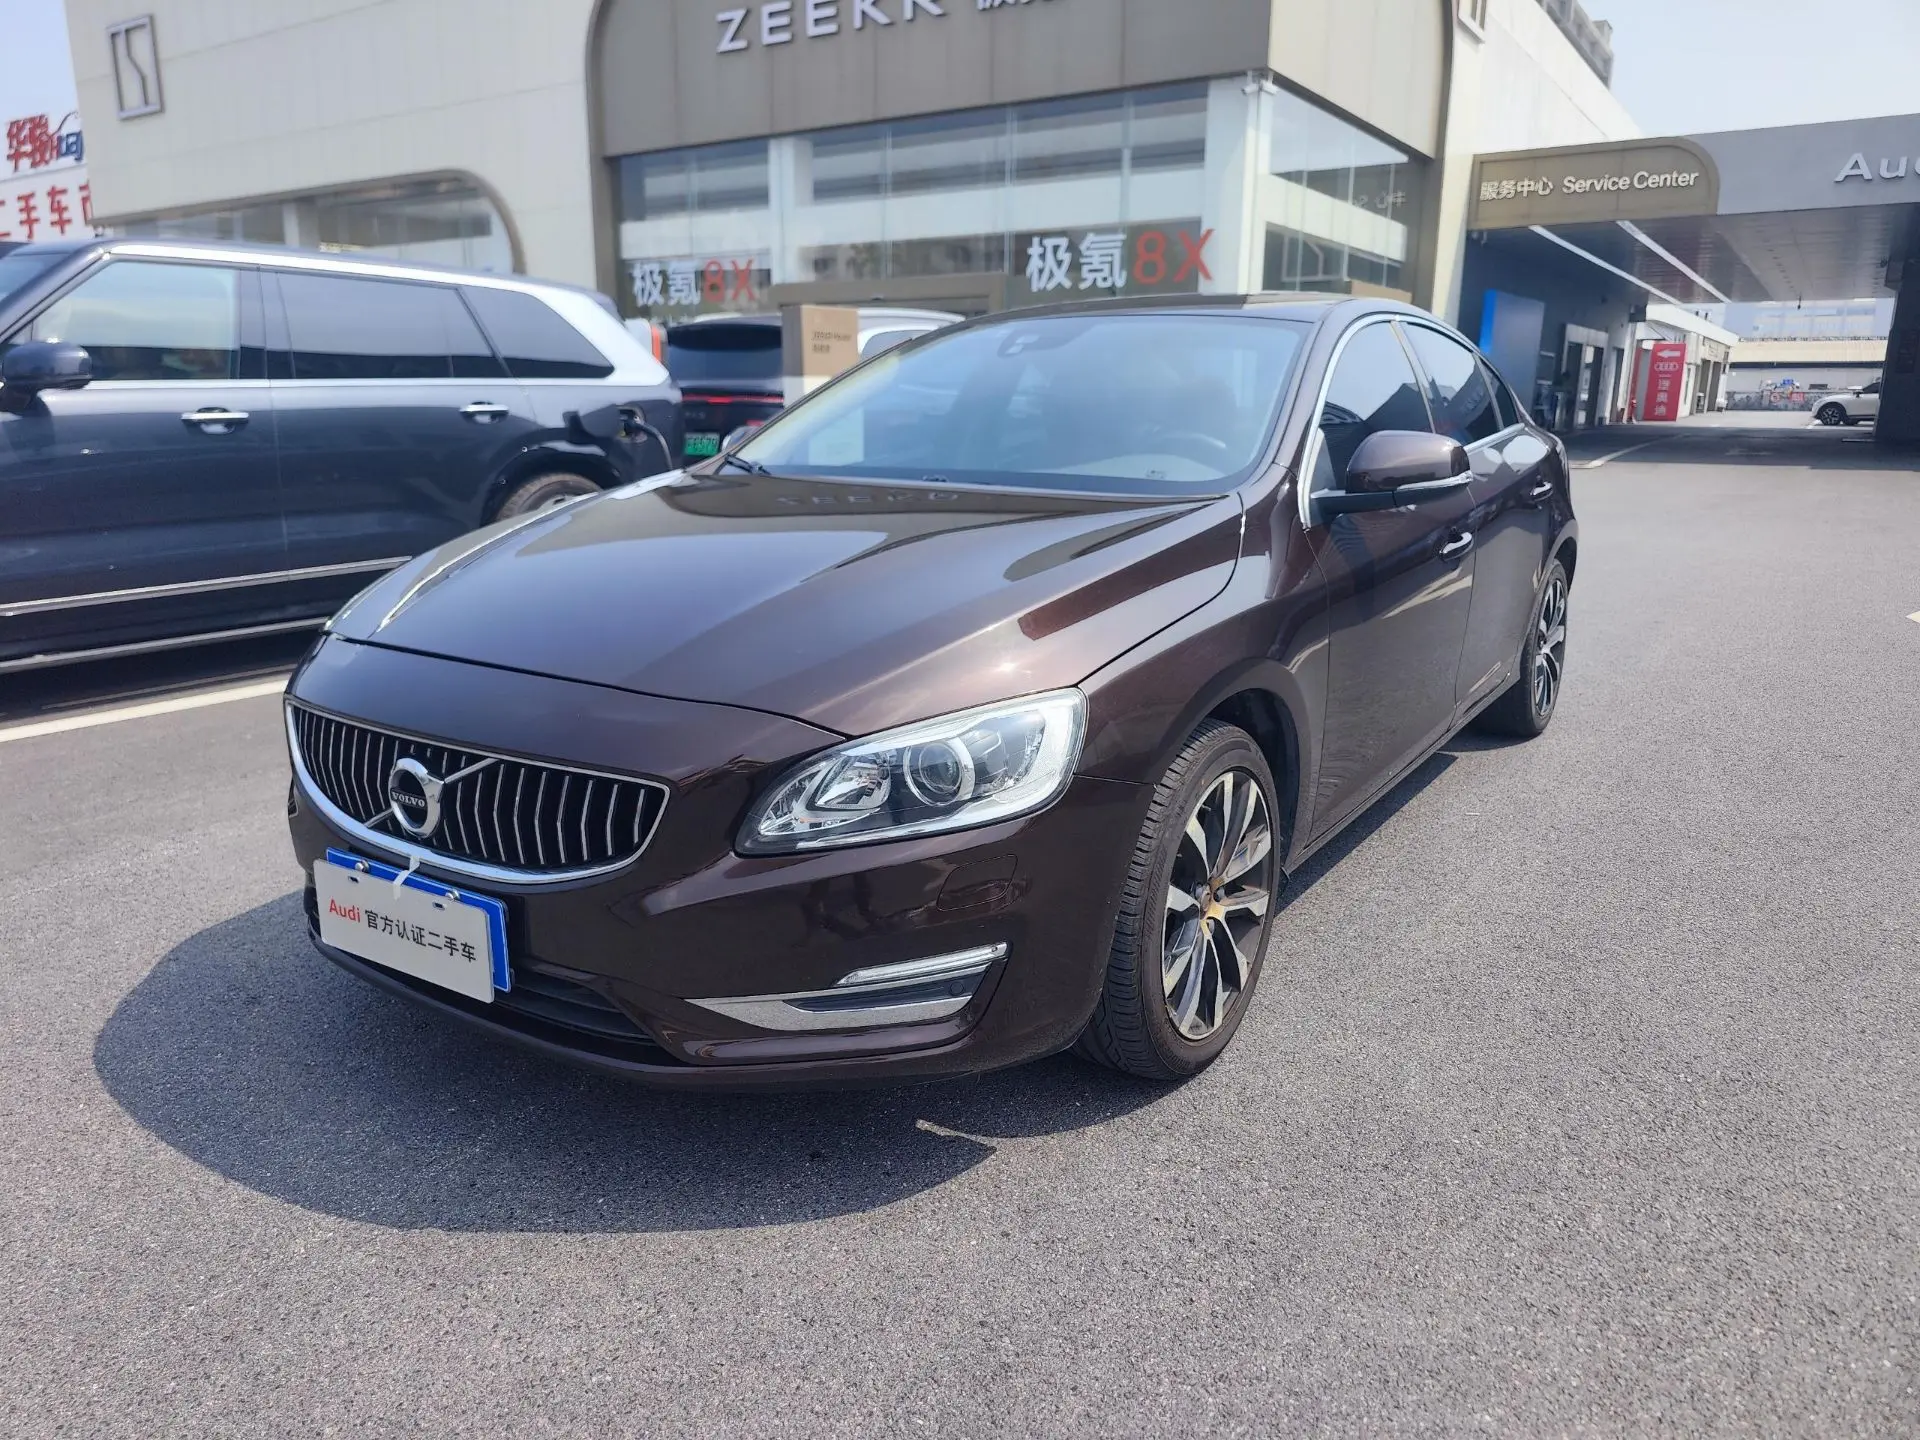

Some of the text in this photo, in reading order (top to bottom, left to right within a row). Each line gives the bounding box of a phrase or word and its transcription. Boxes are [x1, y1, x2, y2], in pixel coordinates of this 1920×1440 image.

[1833, 152, 1920, 183] Au
[1480, 170, 1699, 200] 服务中心 Service Center
[391, 791, 426, 808] VOLVO
[329, 898, 477, 963] Audi 官方认证二手车
